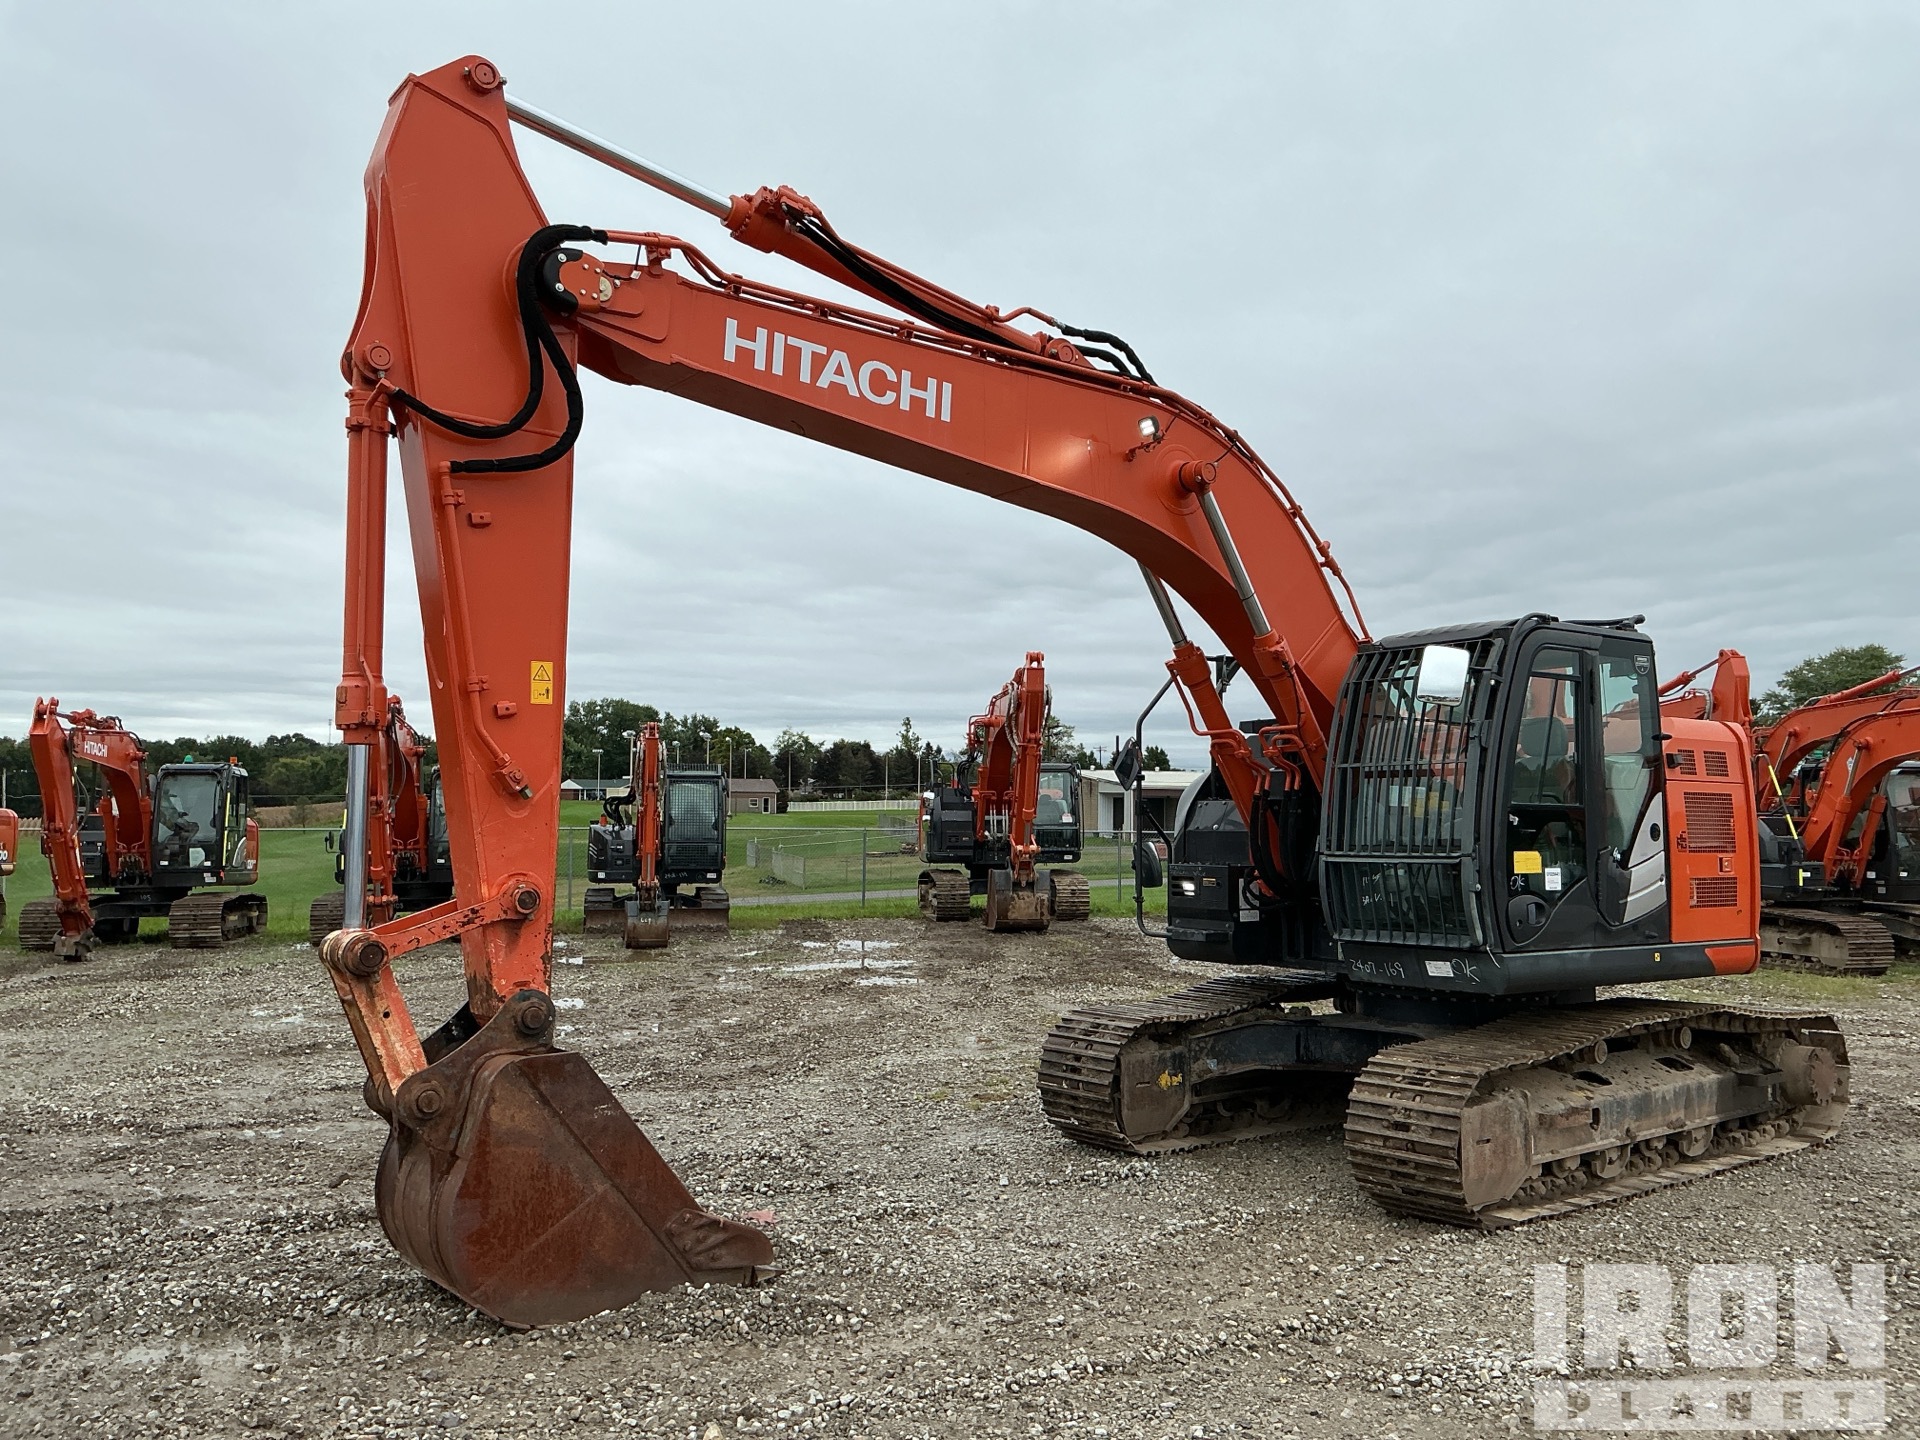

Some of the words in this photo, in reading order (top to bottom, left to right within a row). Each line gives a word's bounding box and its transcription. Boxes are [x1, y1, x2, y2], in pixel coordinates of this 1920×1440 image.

[723, 317, 952, 423] HITACHI
[84, 741, 108, 757] HITACHI
[1349, 959, 1405, 978] 2407-169
